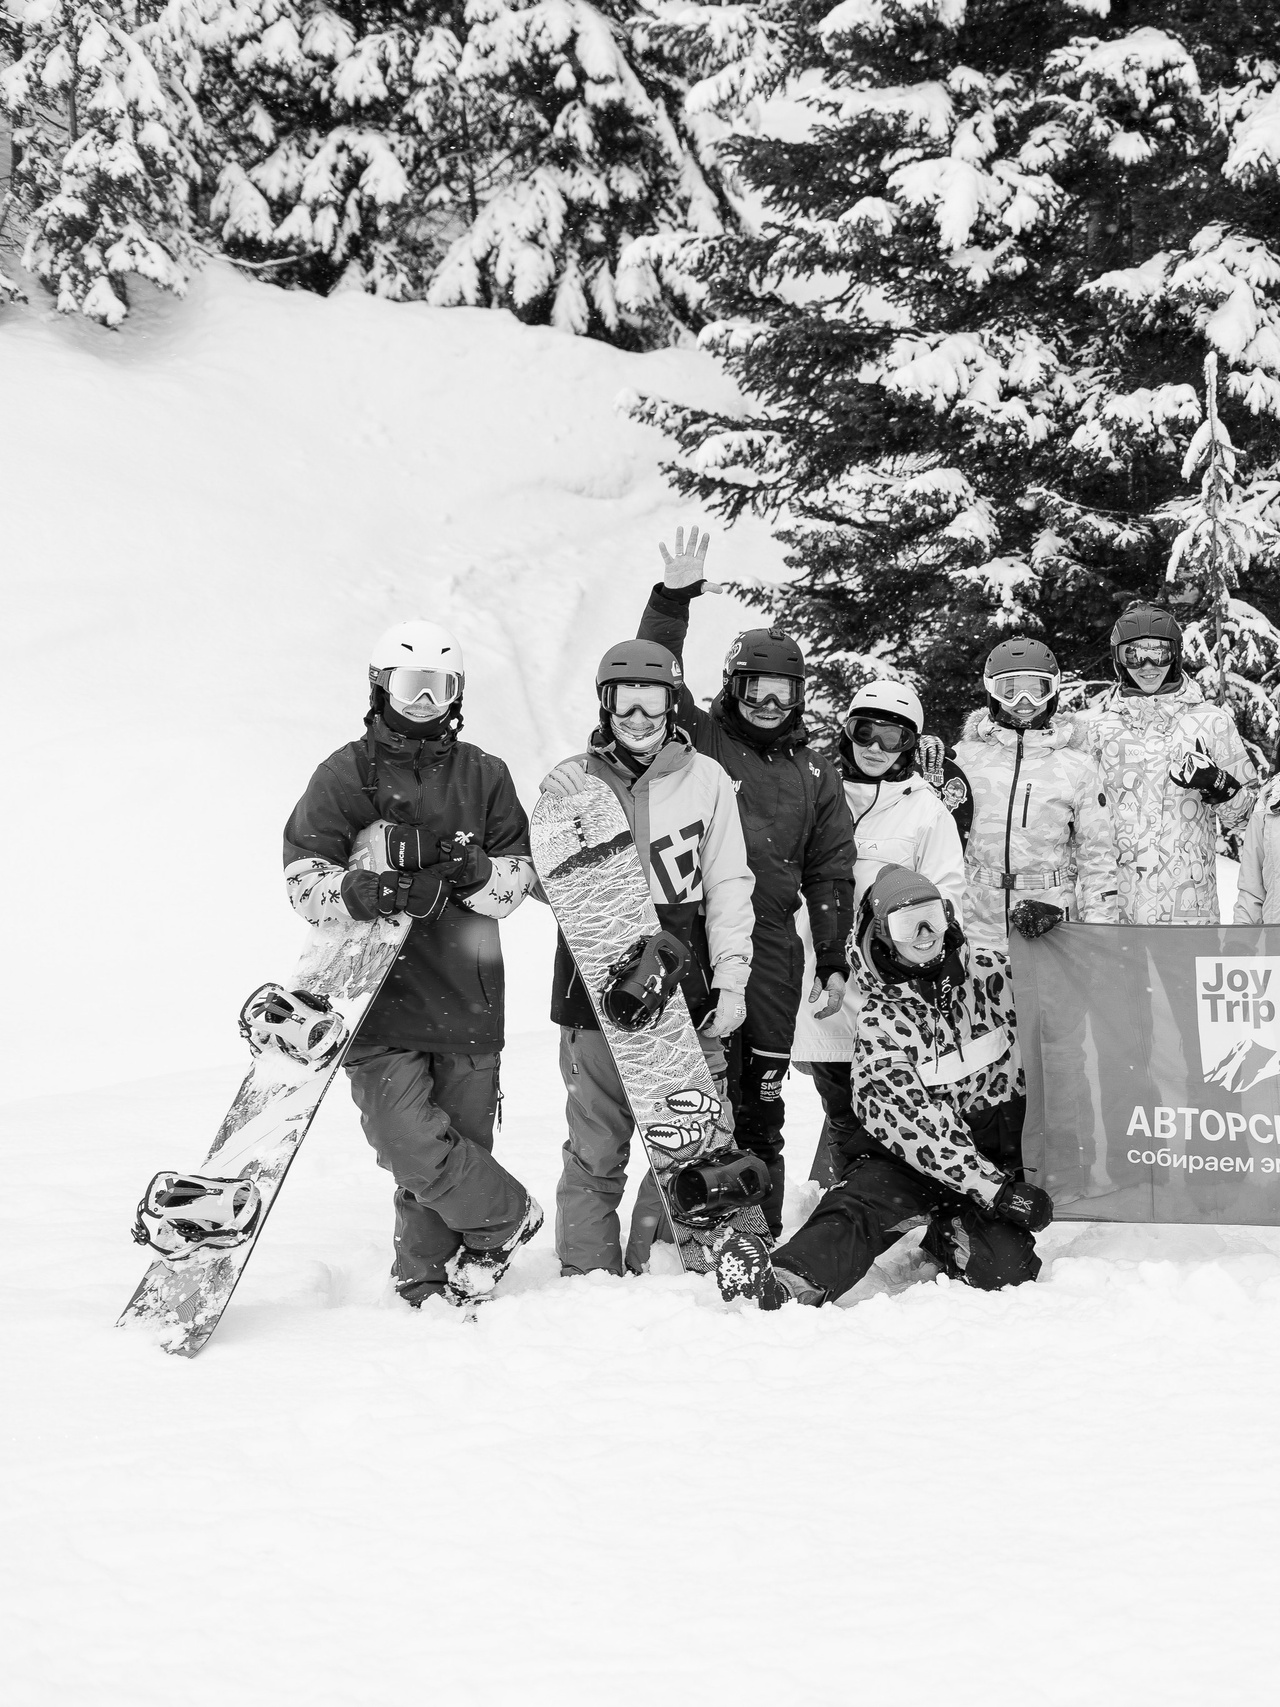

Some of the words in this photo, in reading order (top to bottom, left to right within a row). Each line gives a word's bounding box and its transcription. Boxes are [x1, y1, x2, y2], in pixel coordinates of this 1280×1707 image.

[398, 841, 406, 868] AUCRUX
[1202, 962, 1272, 1000] Joy
[1201, 992, 1276, 1029] Trip
[1126, 1148, 1254, 1174] собираем
